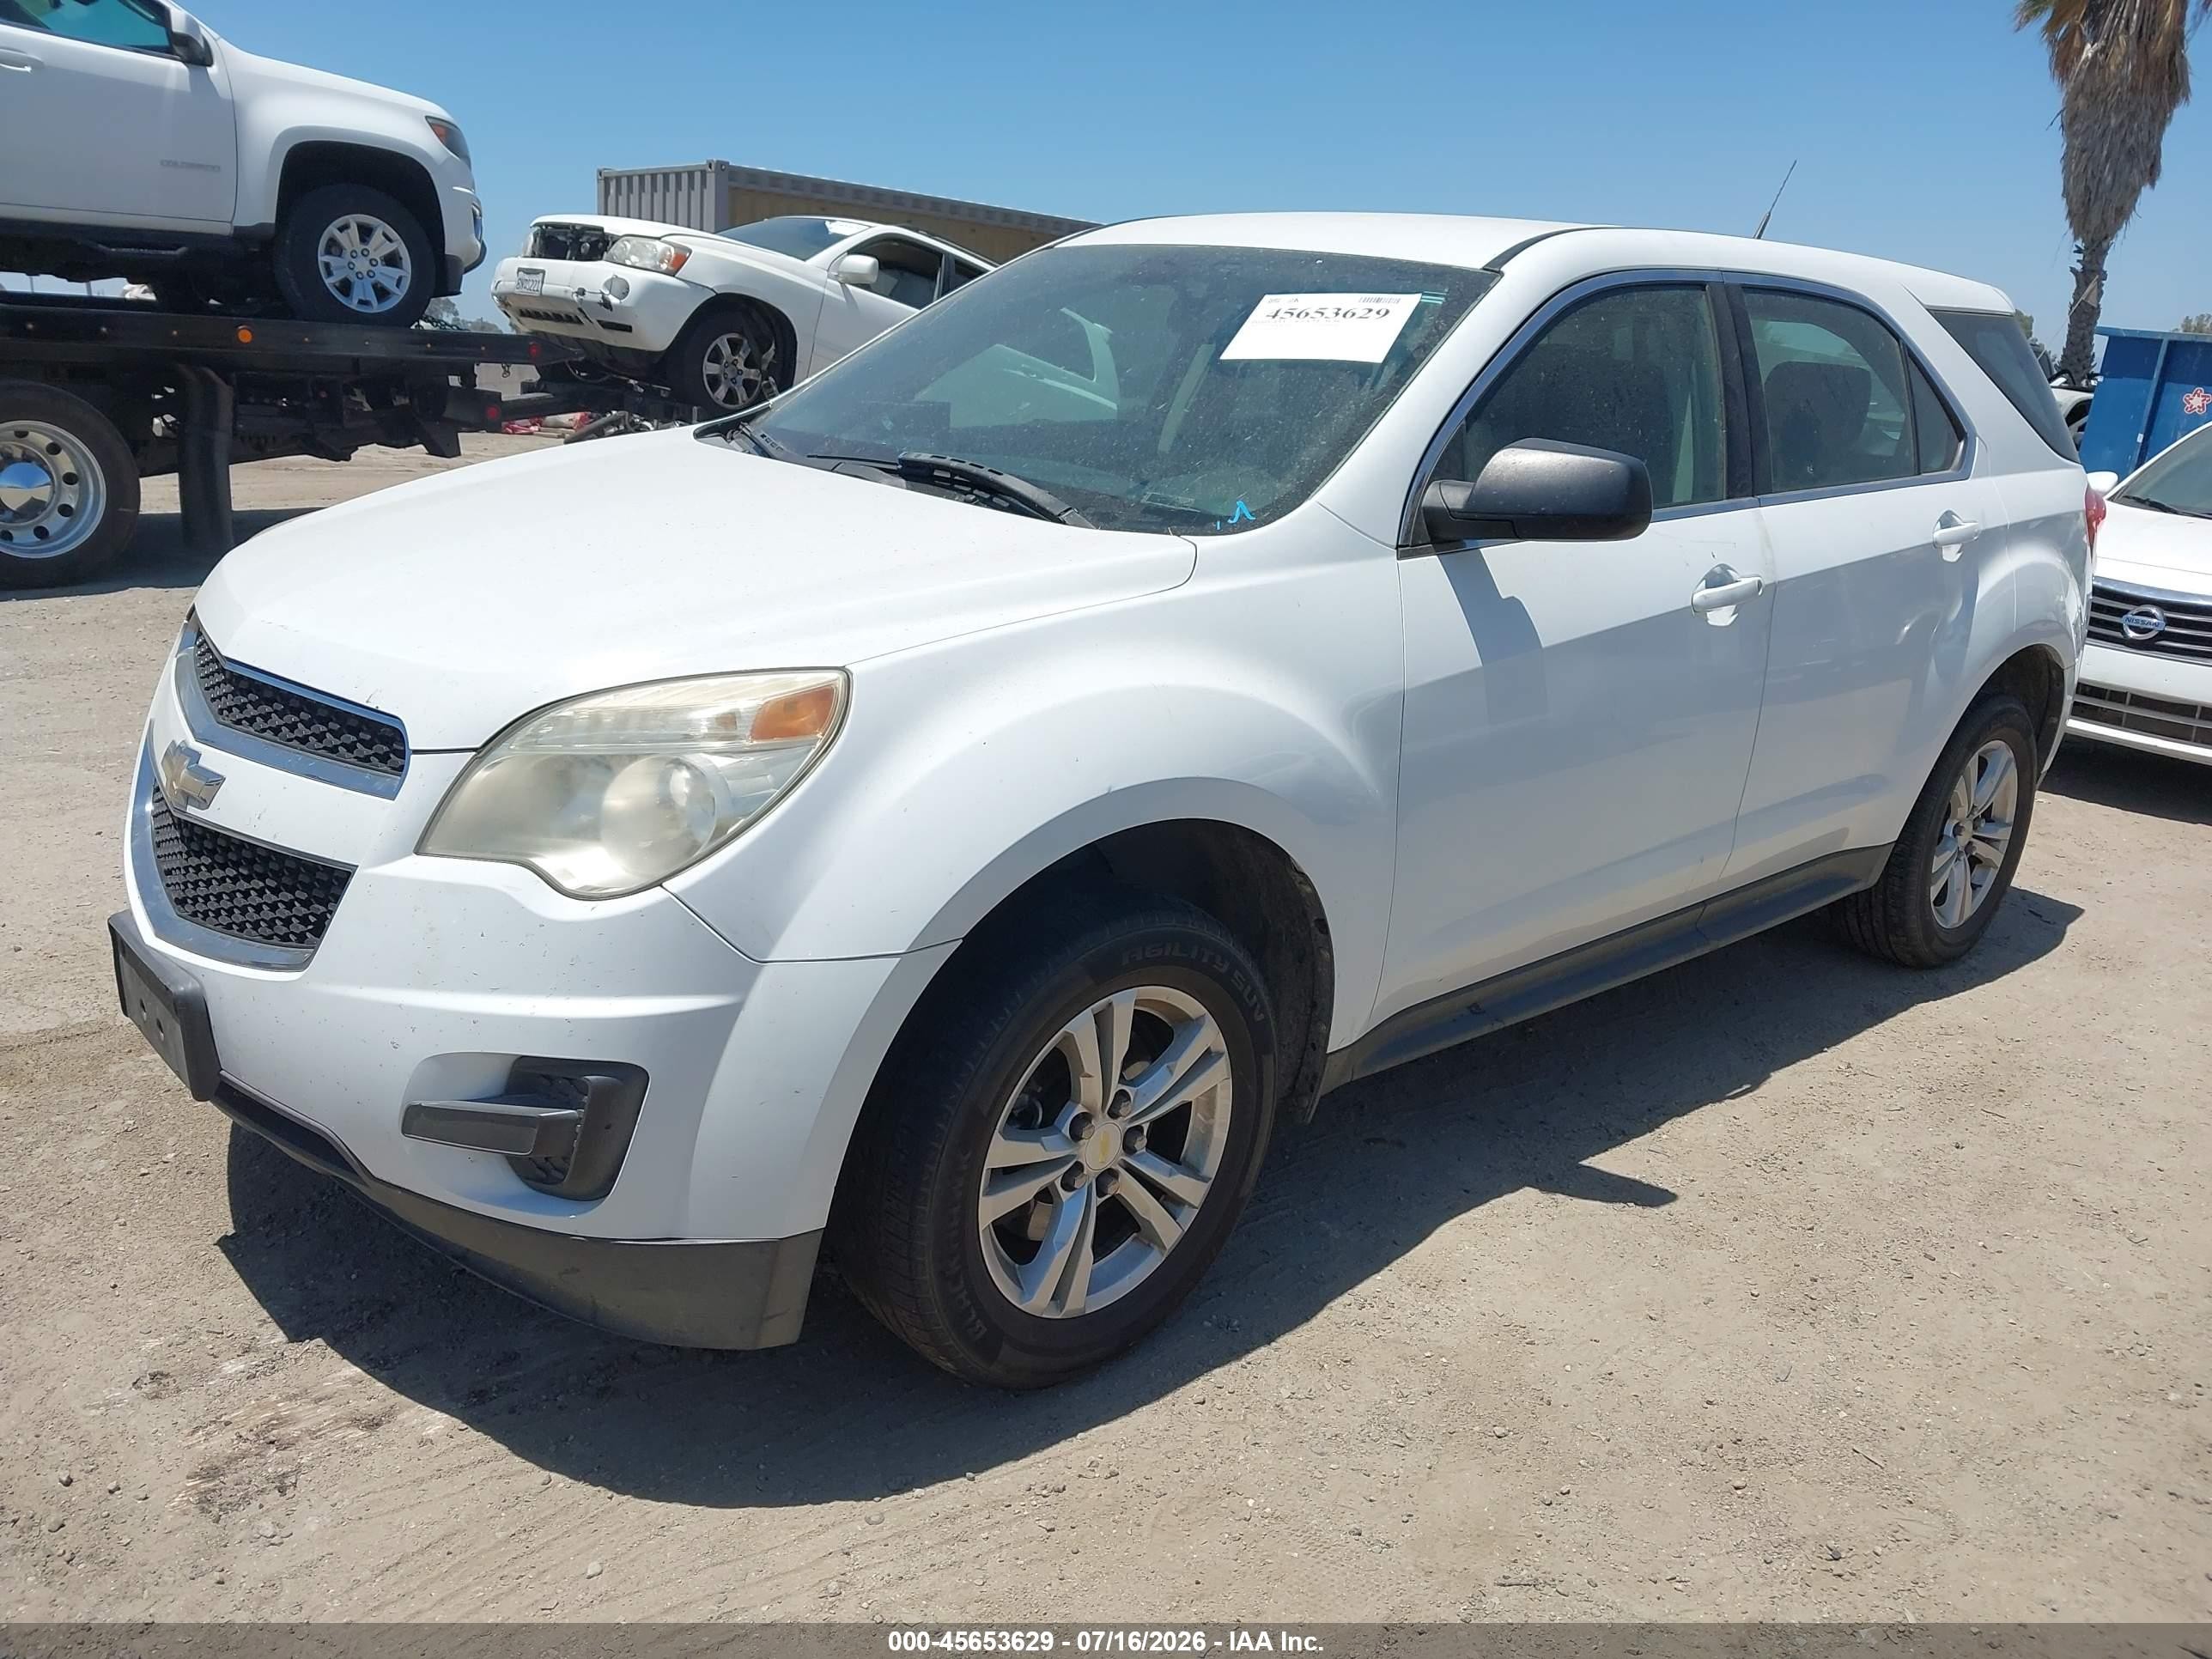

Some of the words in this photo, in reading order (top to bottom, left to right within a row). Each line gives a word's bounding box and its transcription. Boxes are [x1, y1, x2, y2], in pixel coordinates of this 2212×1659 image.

[161, 159, 221, 172] COLDO
[1266, 307, 1391, 320] 45653629
[2124, 617, 2160, 628] NISSAN
[1120, 940, 1231, 975] AGILITY
[1230, 969, 1266, 1023] SUV
